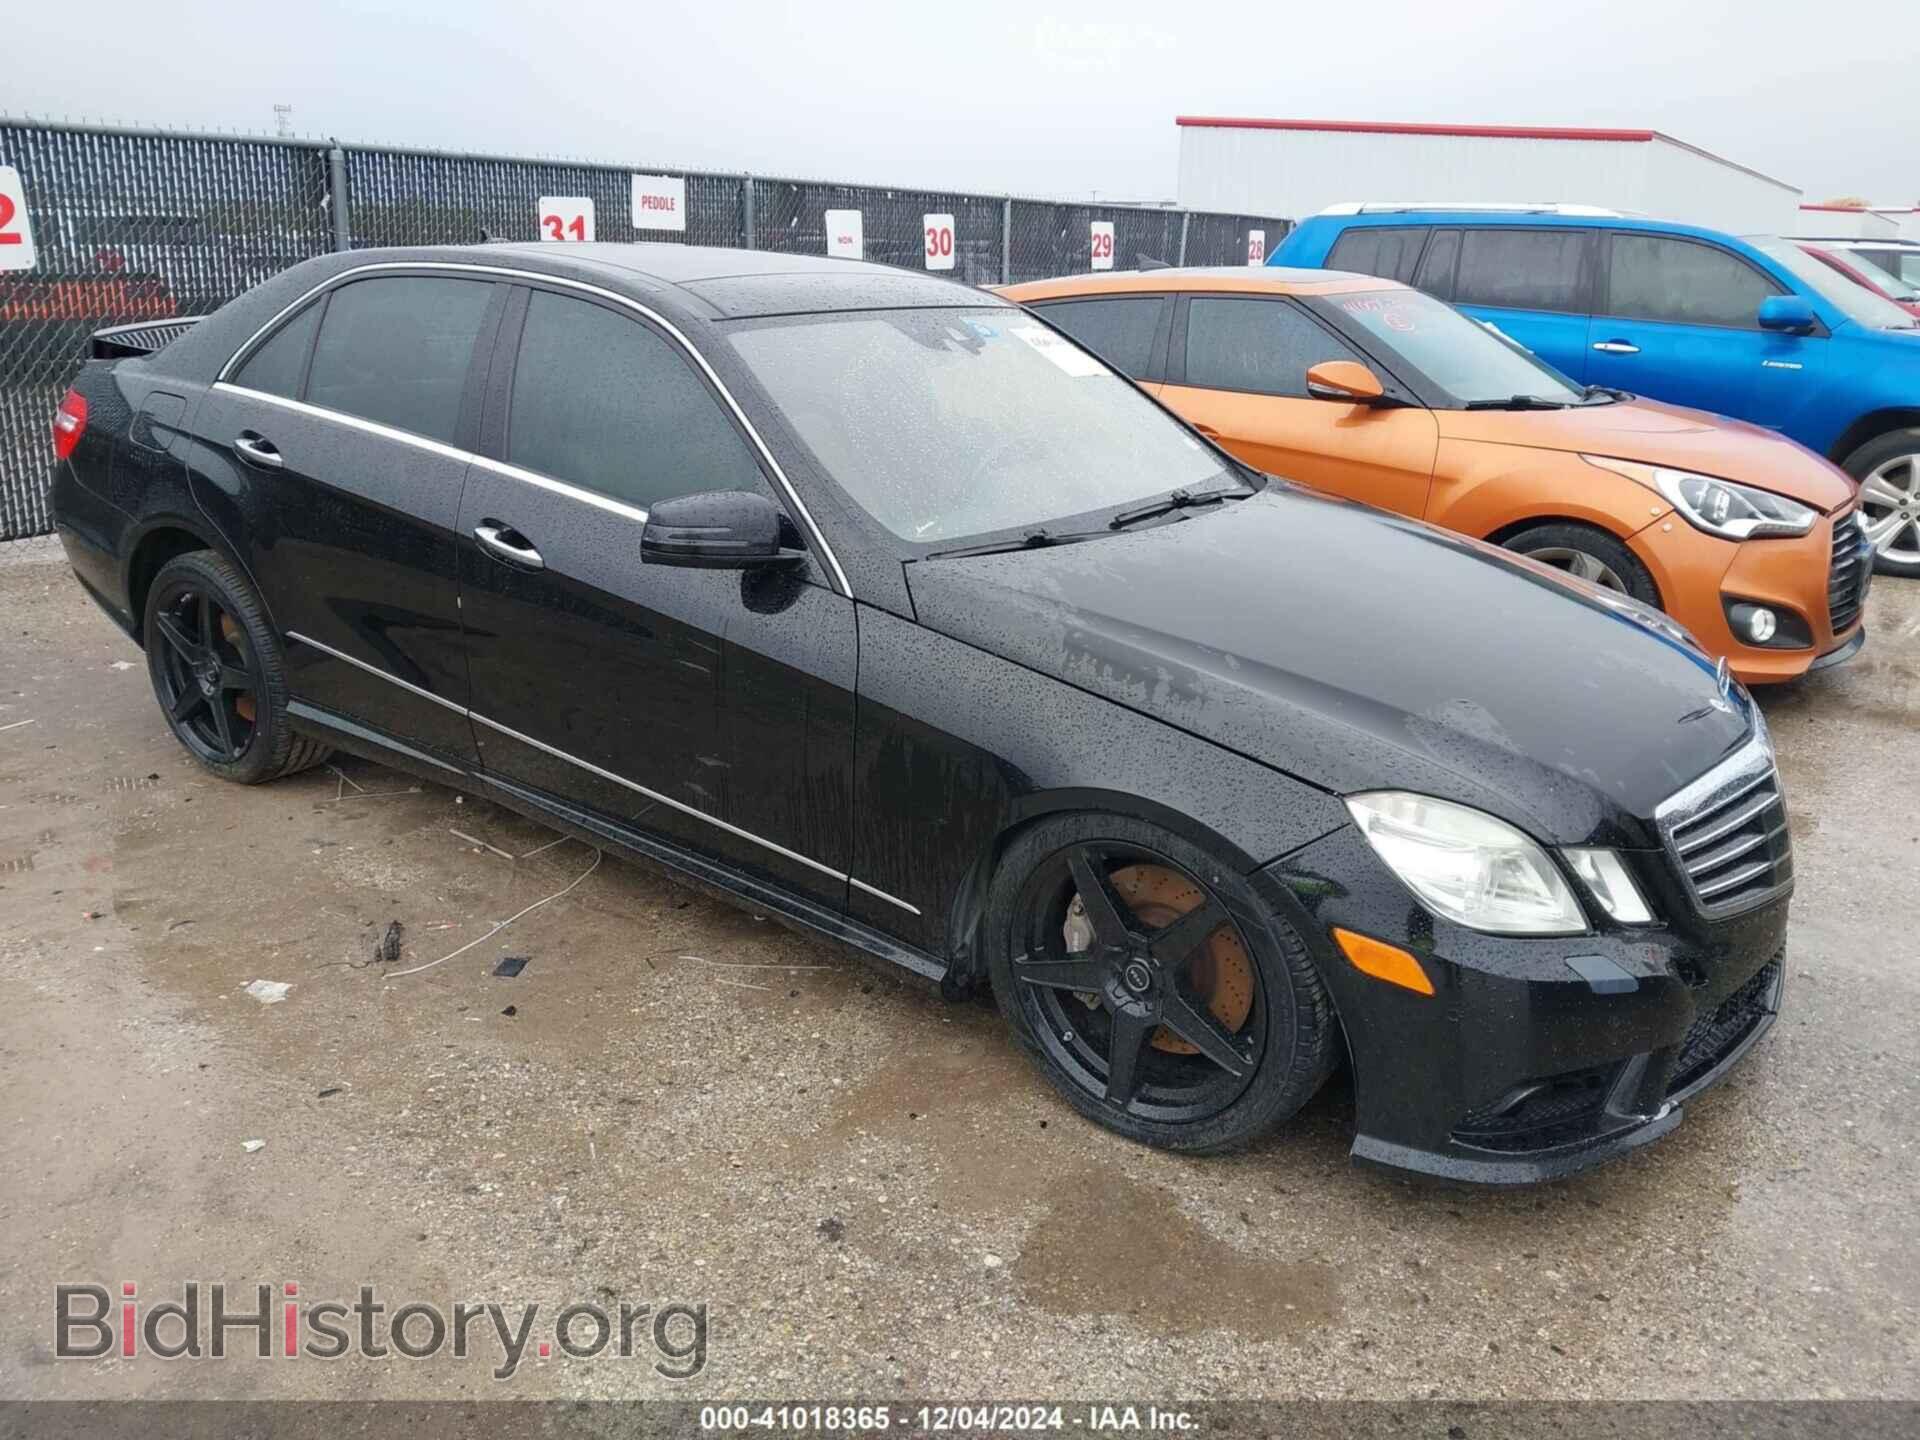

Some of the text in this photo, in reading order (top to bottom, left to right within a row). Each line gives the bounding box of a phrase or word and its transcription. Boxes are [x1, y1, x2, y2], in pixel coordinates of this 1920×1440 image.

[641, 195, 676, 212] PEDDLE
[543, 214, 586, 241] 31
[926, 227, 952, 257] 30
[1091, 233, 1112, 258] 29
[1249, 240, 1263, 260] 28
